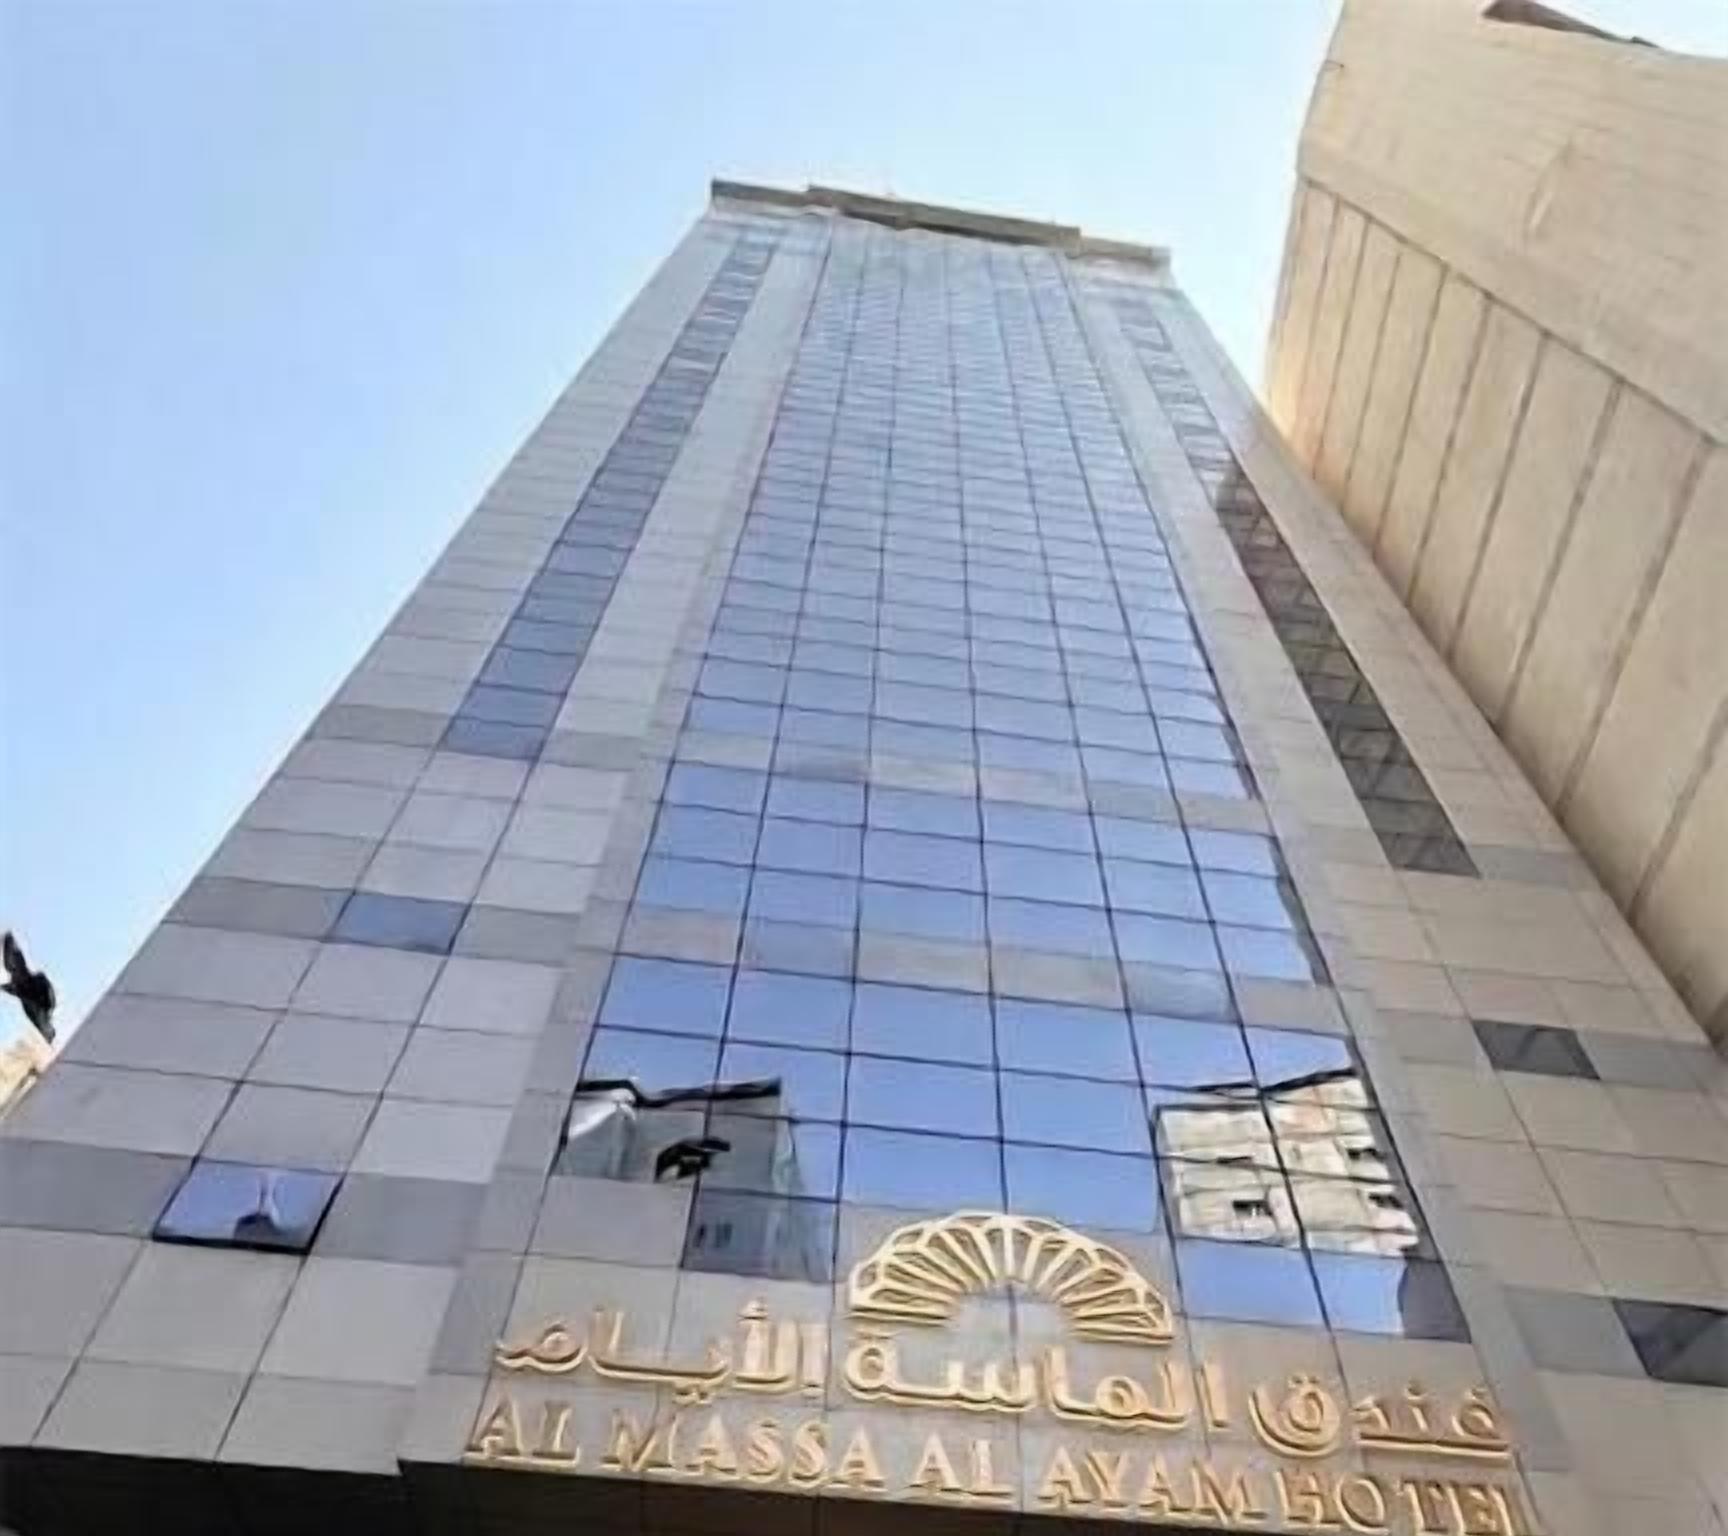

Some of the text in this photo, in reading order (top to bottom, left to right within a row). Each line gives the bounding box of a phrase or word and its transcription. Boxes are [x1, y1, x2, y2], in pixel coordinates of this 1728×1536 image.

[496, 1299, 1512, 1459] فندق الماسة الأيام
[462, 1390, 581, 1468] AL
[598, 1405, 889, 1492] MASSA
[900, 1433, 1018, 1504] AL
[1036, 1446, 1271, 1528] AYAM
